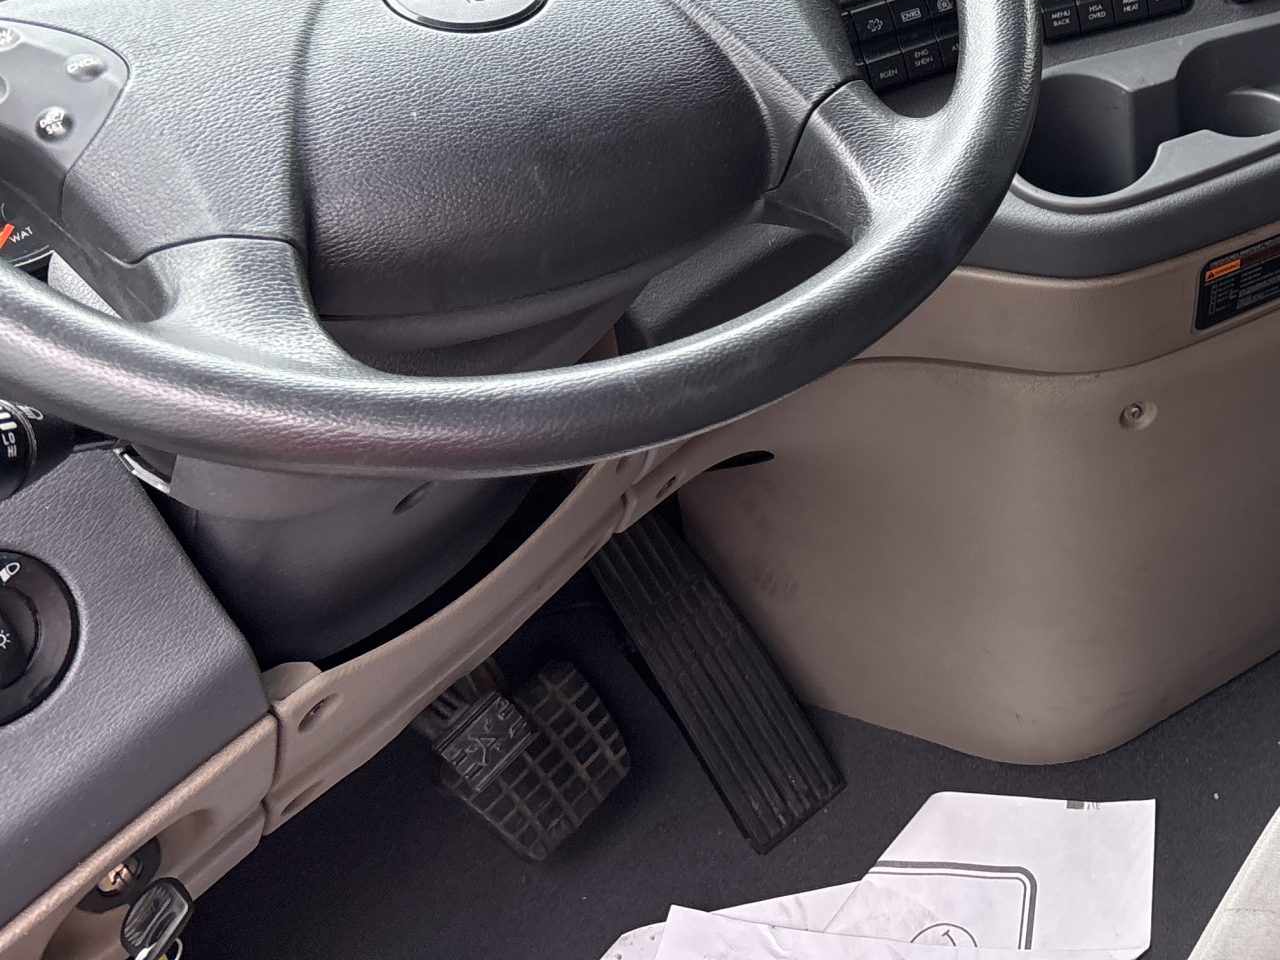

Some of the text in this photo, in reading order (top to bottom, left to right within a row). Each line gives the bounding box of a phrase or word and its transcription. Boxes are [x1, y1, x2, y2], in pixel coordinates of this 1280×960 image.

[1088, 4, 1103, 12] HSA
[1123, 3, 1139, 12] HEAT
[1051, 10, 1071, 19] MENU
[1088, 11, 1106, 20] OVRD
[1053, 18, 1071, 27] BACK
[914, 49, 929, 58] ENG
[914, 56, 934, 67] SHDN
[880, 68, 898, 79] RGEN
[1, 432, 15, 446] LO
[7, 445, 17, 458] HI
